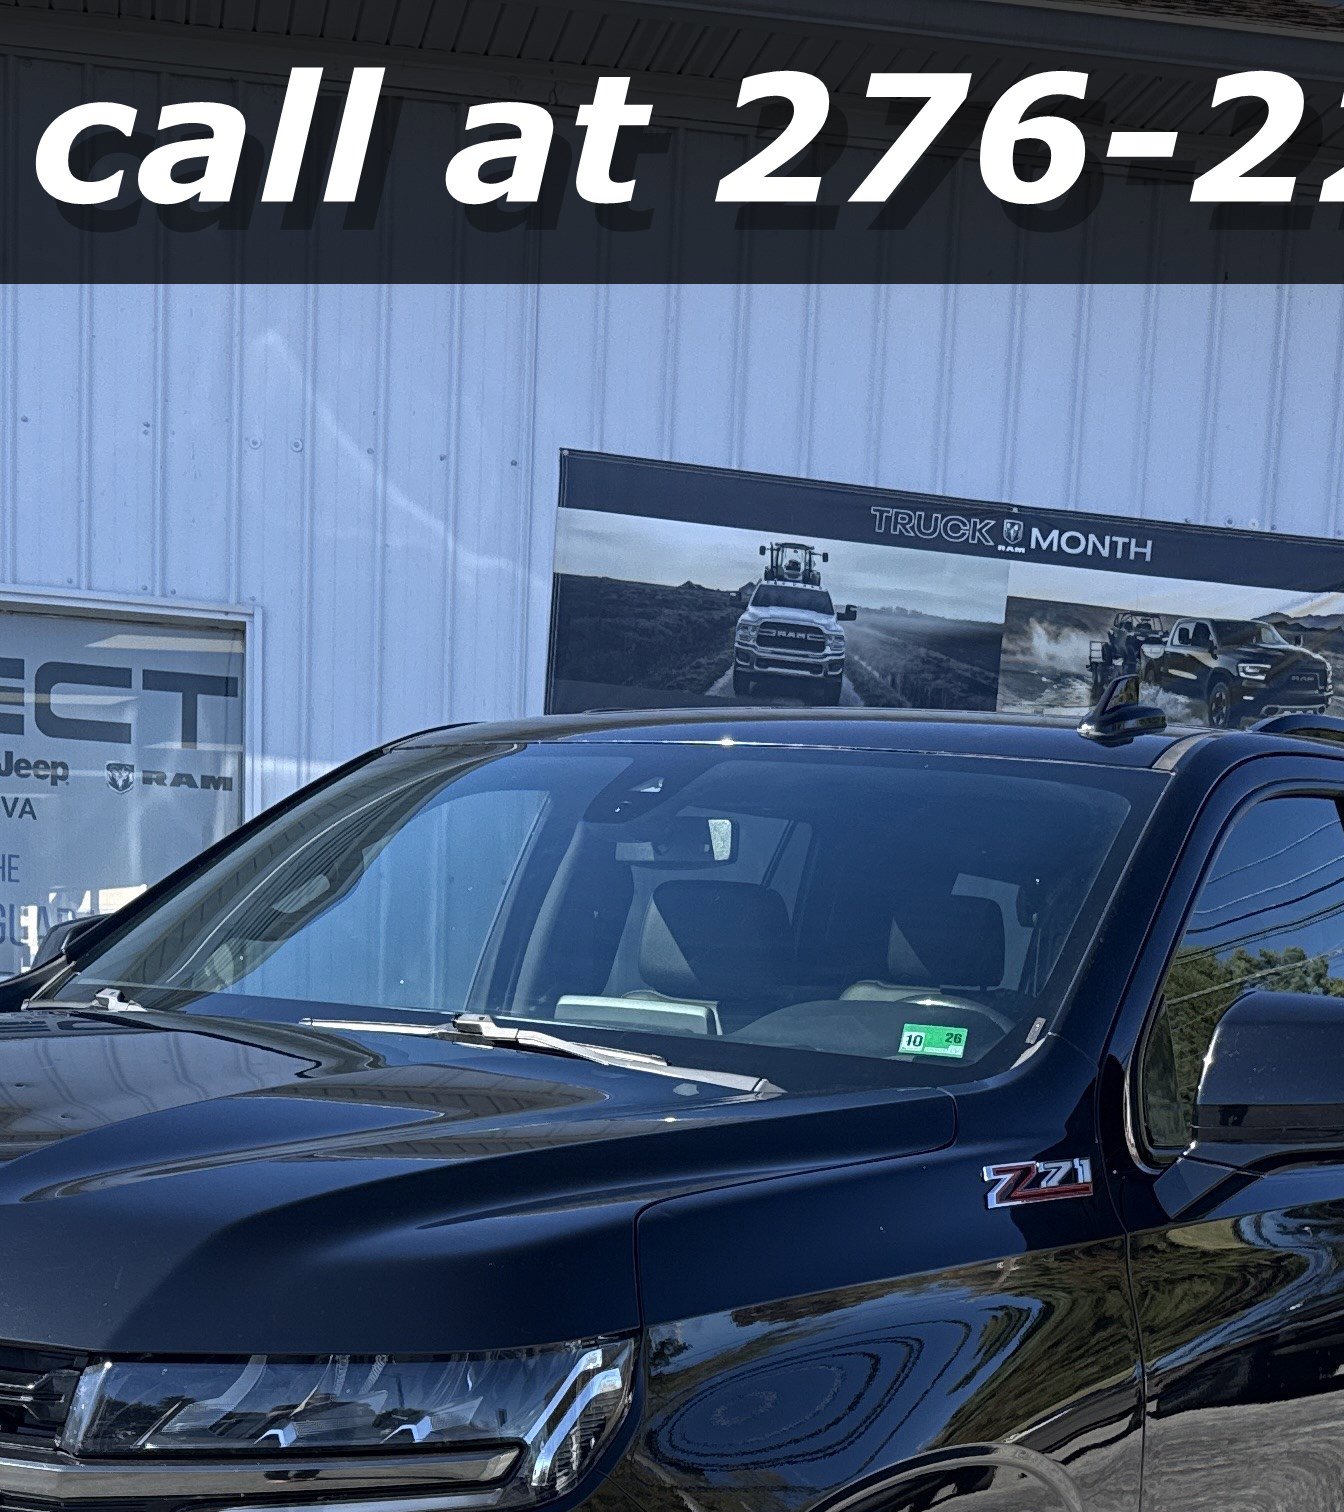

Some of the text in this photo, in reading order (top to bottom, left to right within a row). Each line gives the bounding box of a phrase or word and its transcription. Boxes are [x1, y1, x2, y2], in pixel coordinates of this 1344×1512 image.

[871, 506, 1153, 562] TRUCK MONTH
[997, 545, 1025, 554] RAM
[777, 630, 805, 640] RAM
[142, 770, 234, 792] RAM
[1, 795, 37, 821] VA
[906, 1034, 923, 1047] 10
[945, 1032, 963, 1044] 26
[982, 1157, 1094, 1209] Z71
